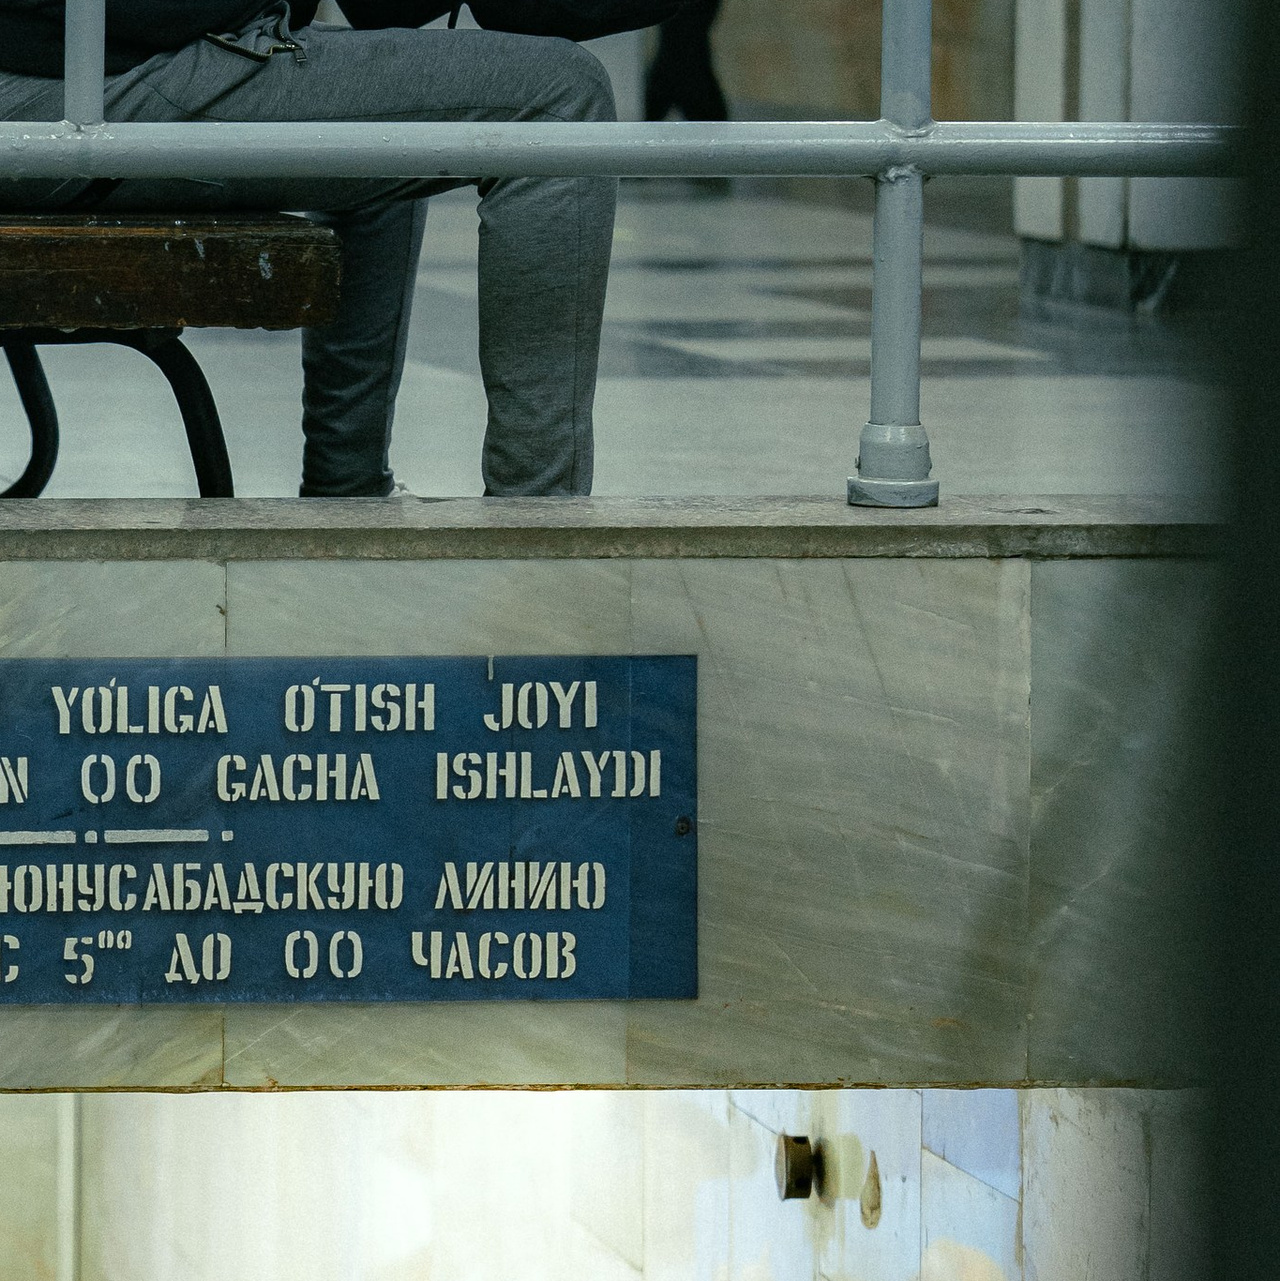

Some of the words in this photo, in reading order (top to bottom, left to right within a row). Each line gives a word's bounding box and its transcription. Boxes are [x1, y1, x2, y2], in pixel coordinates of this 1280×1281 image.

[484, 681, 597, 732] JOYI
[217, 753, 381, 802] GACHA
[437, 750, 661, 800] ISHLAYDI
[434, 861, 606, 910] ЛИНИЮ
[165, 932, 232, 984] ДО
[411, 931, 577, 979] ЧАСОВ
